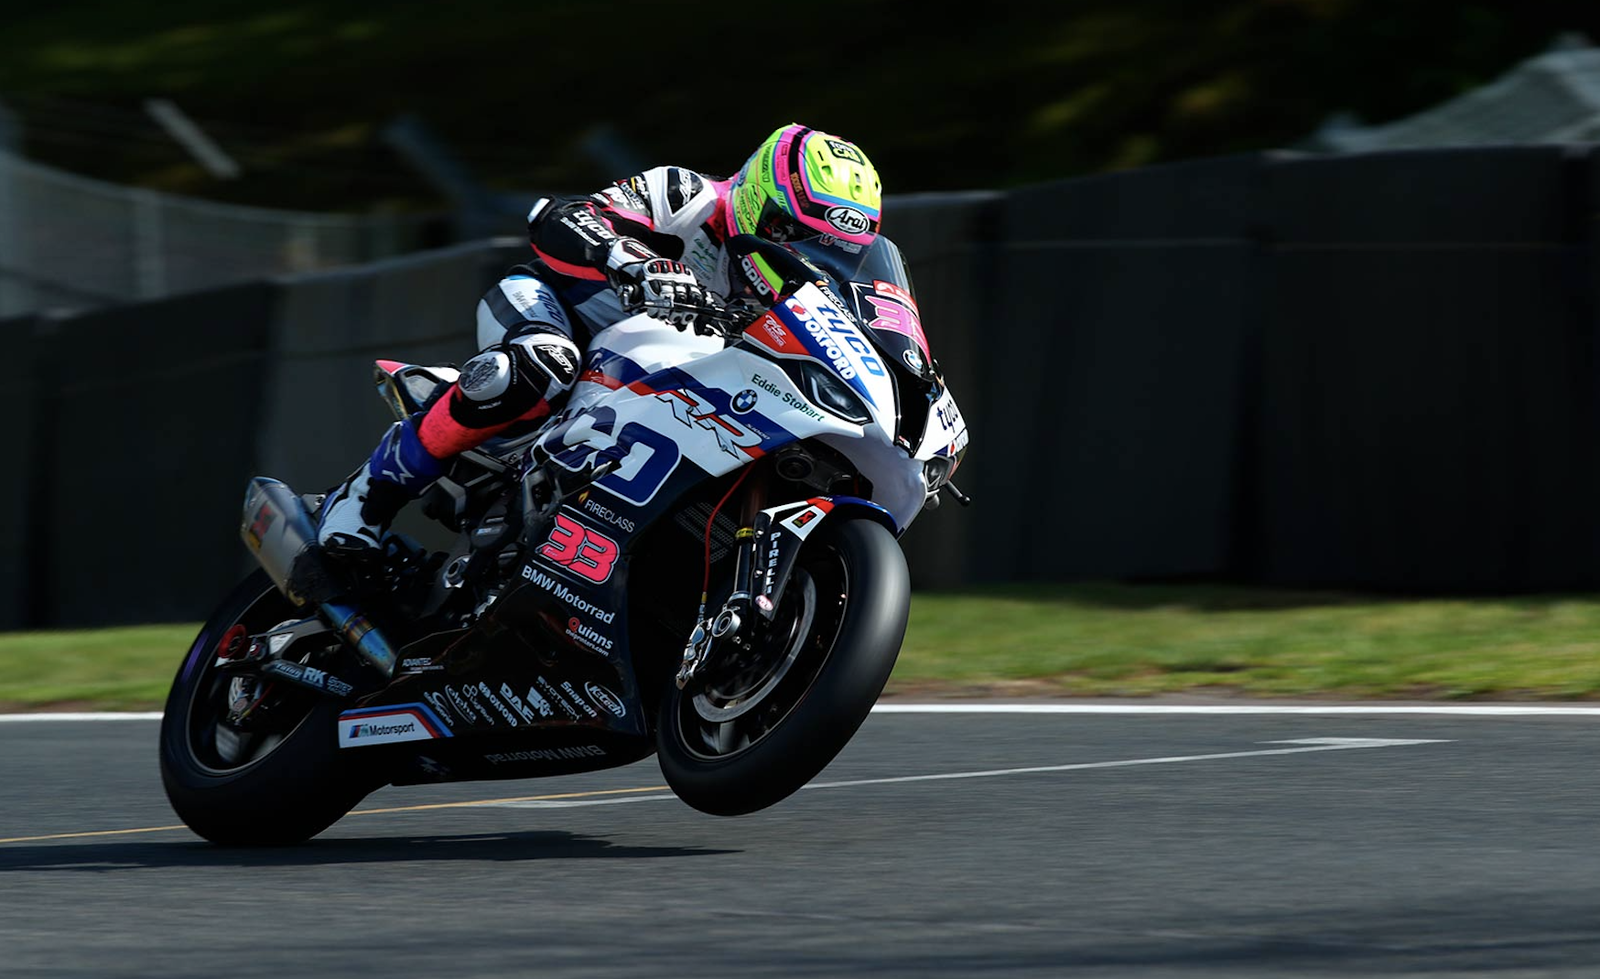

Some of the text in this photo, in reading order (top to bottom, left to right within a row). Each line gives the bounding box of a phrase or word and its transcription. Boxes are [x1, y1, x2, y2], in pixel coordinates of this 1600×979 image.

[573, 210, 614, 240] tyco
[832, 208, 865, 228] Arai
[805, 317, 857, 380] OXFORD
[816, 304, 885, 377] tyco
[751, 374, 825, 422] Eddie Stobart
[654, 388, 763, 460] RR
[584, 499, 636, 534] FIRECLASS
[536, 512, 620, 584] 33
[766, 531, 782, 594] PIRELLI
[521, 565, 615, 625] BMW Motorrad
[568, 616, 614, 650] Quinns
[303, 667, 326, 686] RK
[488, 693, 518, 728] OXFORD
[499, 682, 535, 723] DAF
[369, 722, 415, 738] Motorsport
[484, 745, 607, 765] BMW Motorrad
